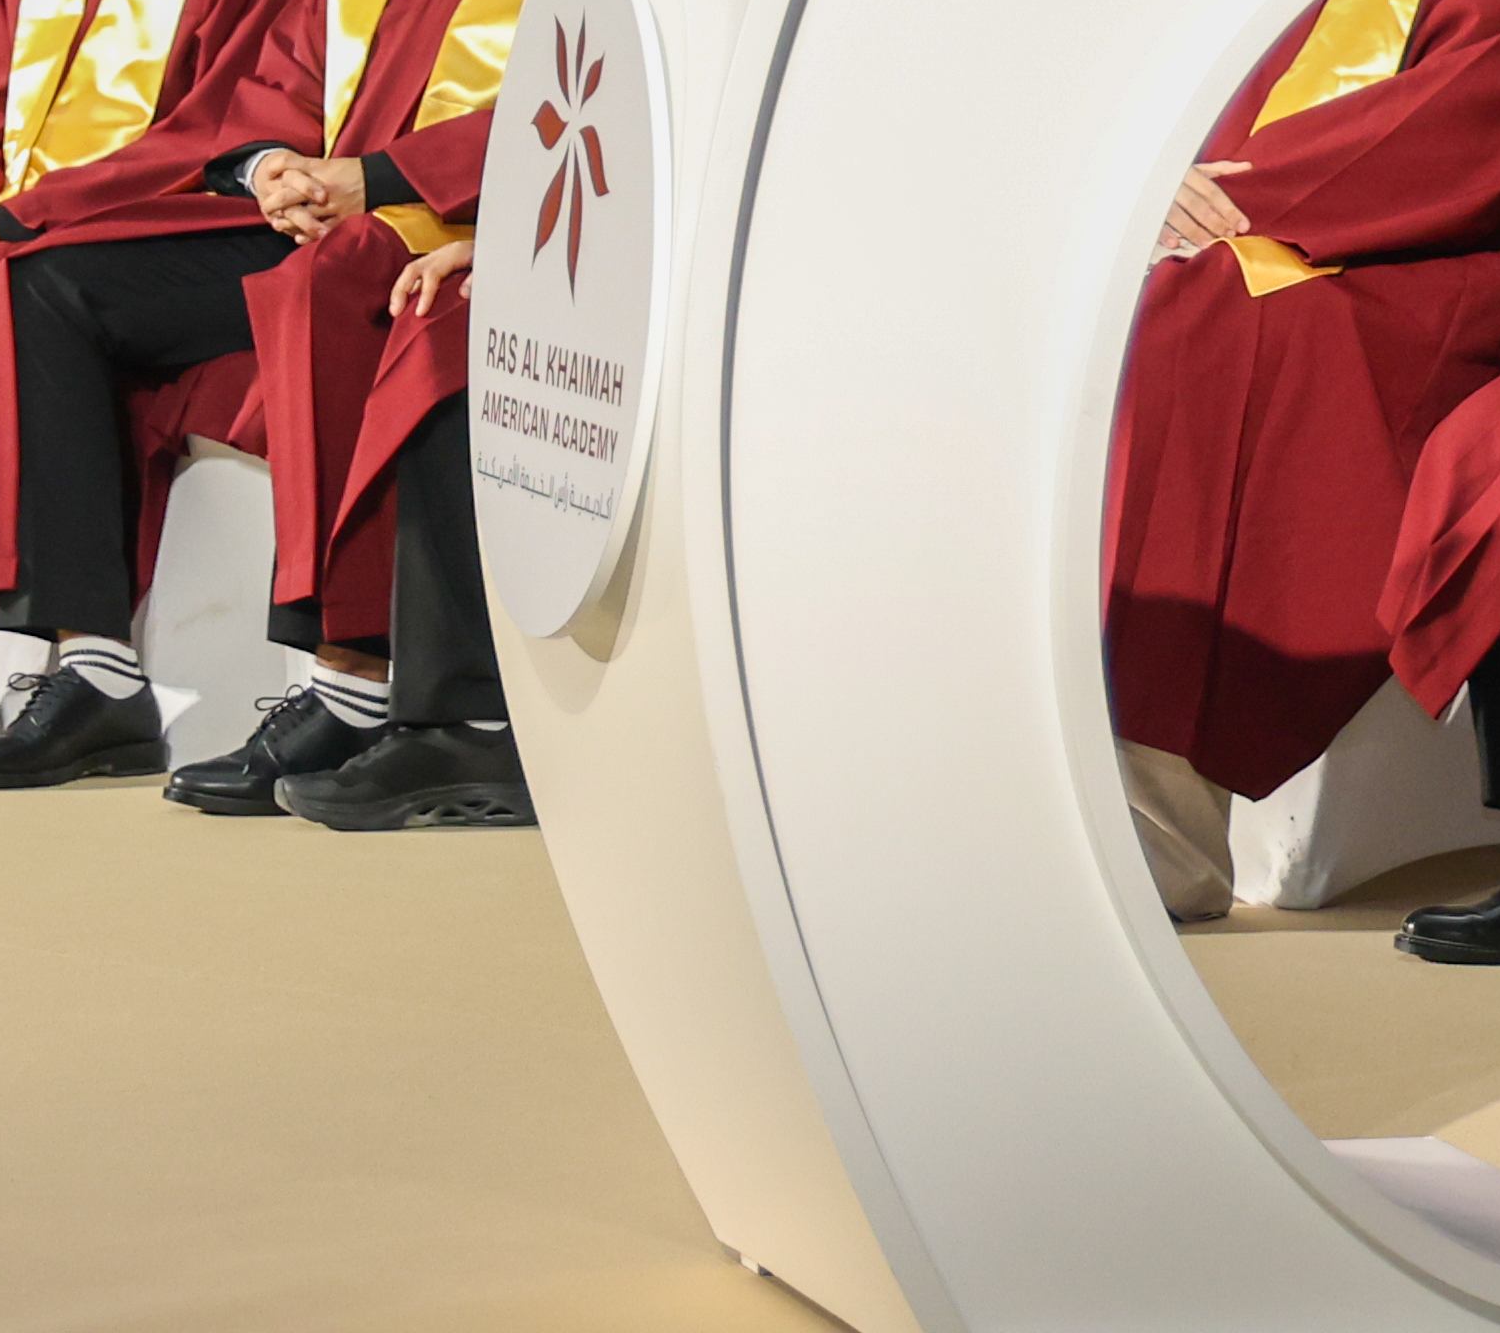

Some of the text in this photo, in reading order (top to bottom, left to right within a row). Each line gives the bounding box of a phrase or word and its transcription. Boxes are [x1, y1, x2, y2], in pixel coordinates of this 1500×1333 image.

[486, 327, 625, 407] RAS AL KHAIMAH
[481, 390, 619, 464] AMERICAN ACADEMY
